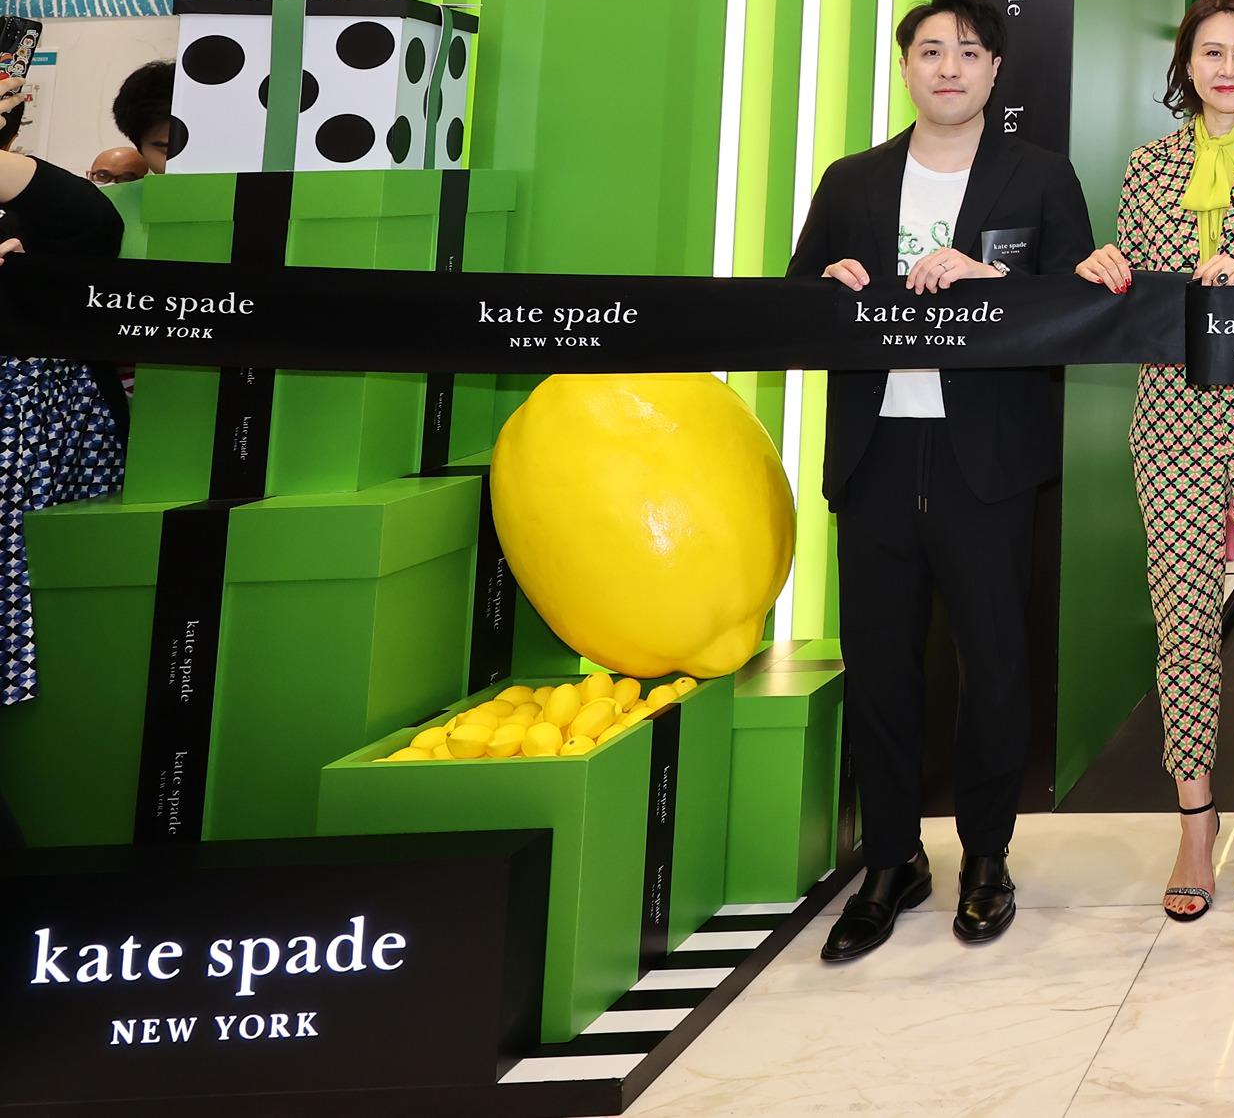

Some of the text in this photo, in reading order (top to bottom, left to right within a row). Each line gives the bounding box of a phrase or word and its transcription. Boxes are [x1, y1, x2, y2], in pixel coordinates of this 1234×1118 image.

[1009, 241, 1027, 250] spade
[86, 285, 255, 321] kate spade
[478, 301, 638, 331] kate spade
[854, 301, 1004, 330] kate spade
[117, 324, 214, 339] NEW YORK
[509, 336, 601, 348] NEW YORK
[882, 334, 967, 346] NEW YORK
[239, 416, 252, 460] kate spade
[178, 620, 200, 702] kate spade
[166, 751, 188, 835] kate spade
[30, 915, 407, 997] kate spade
[109, 1011, 319, 1045] NEW YORK
